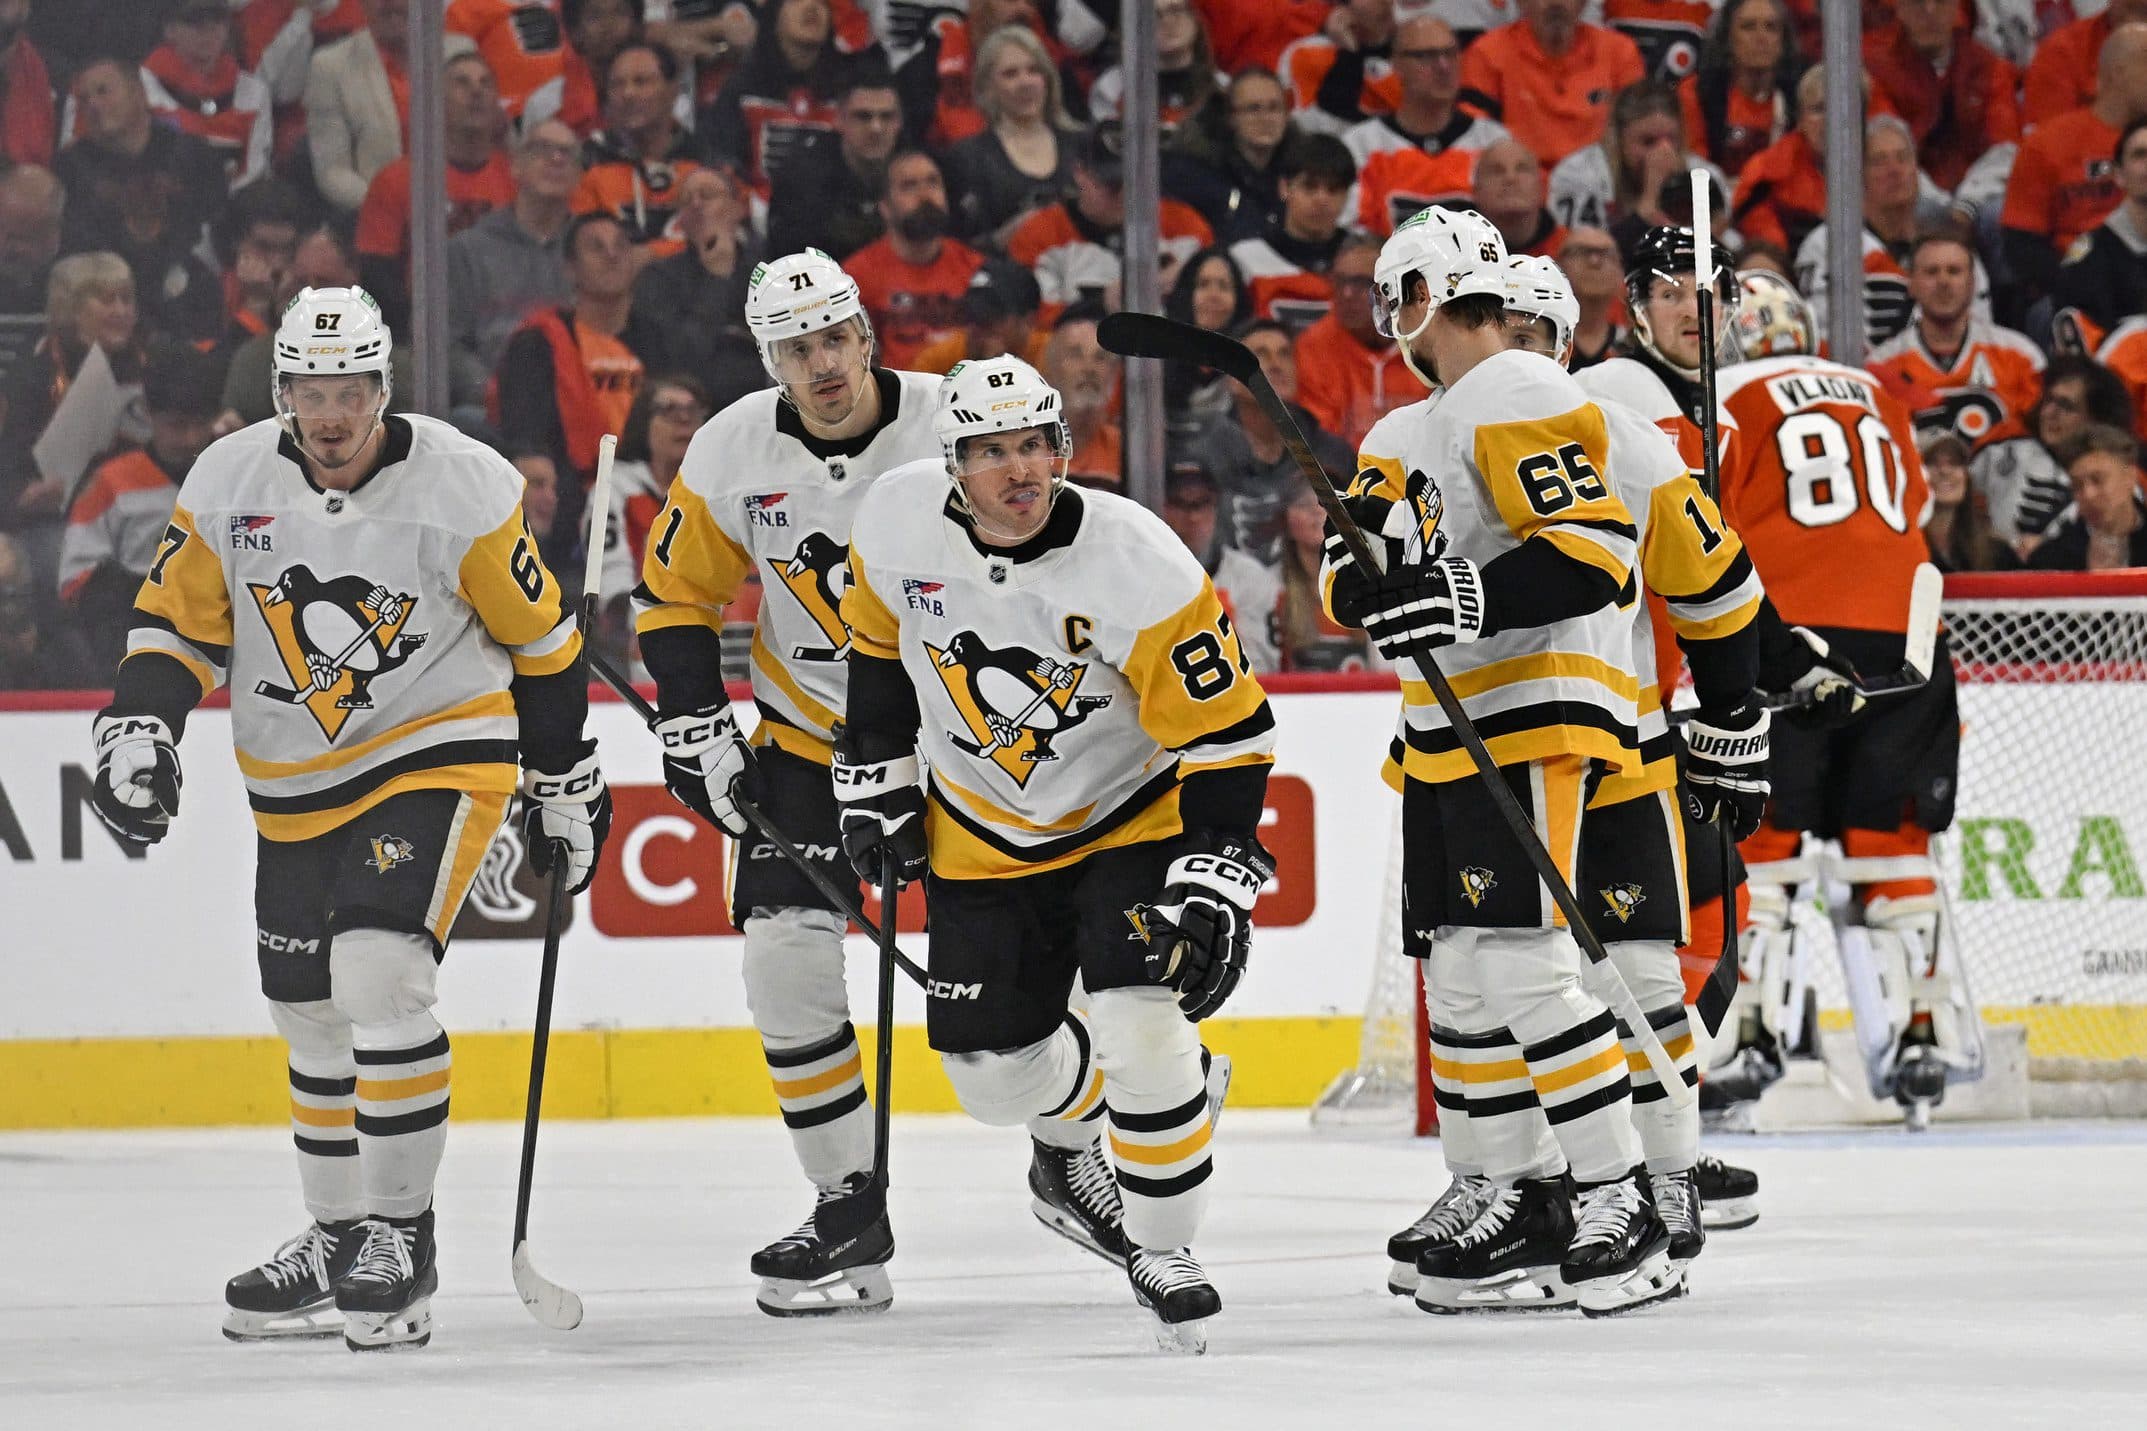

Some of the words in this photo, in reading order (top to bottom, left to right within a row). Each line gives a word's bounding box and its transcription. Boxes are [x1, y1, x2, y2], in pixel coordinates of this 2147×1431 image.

[1478, 242, 1499, 263] 65
[788, 272, 814, 291] 71
[315, 313, 341, 330] 67
[306, 346, 347, 355] CCM
[986, 371, 1014, 388] 87
[991, 400, 1028, 412] CCM
[1515, 441, 1609, 518] 65
[1775, 410, 1910, 535] 80
[231, 534, 274, 552] F.N.B.
[907, 595, 946, 619] F.N.B.
[1063, 614, 1096, 657] C
[96, 720, 161, 749] CM
[662, 713, 738, 748] CCM
[1222, 845, 1241, 858] 87
[1184, 857, 1259, 895] CCM
[258, 927, 321, 954] CCM
[926, 979, 983, 1000] CCM
[1489, 1237, 1528, 1261] BAUER
